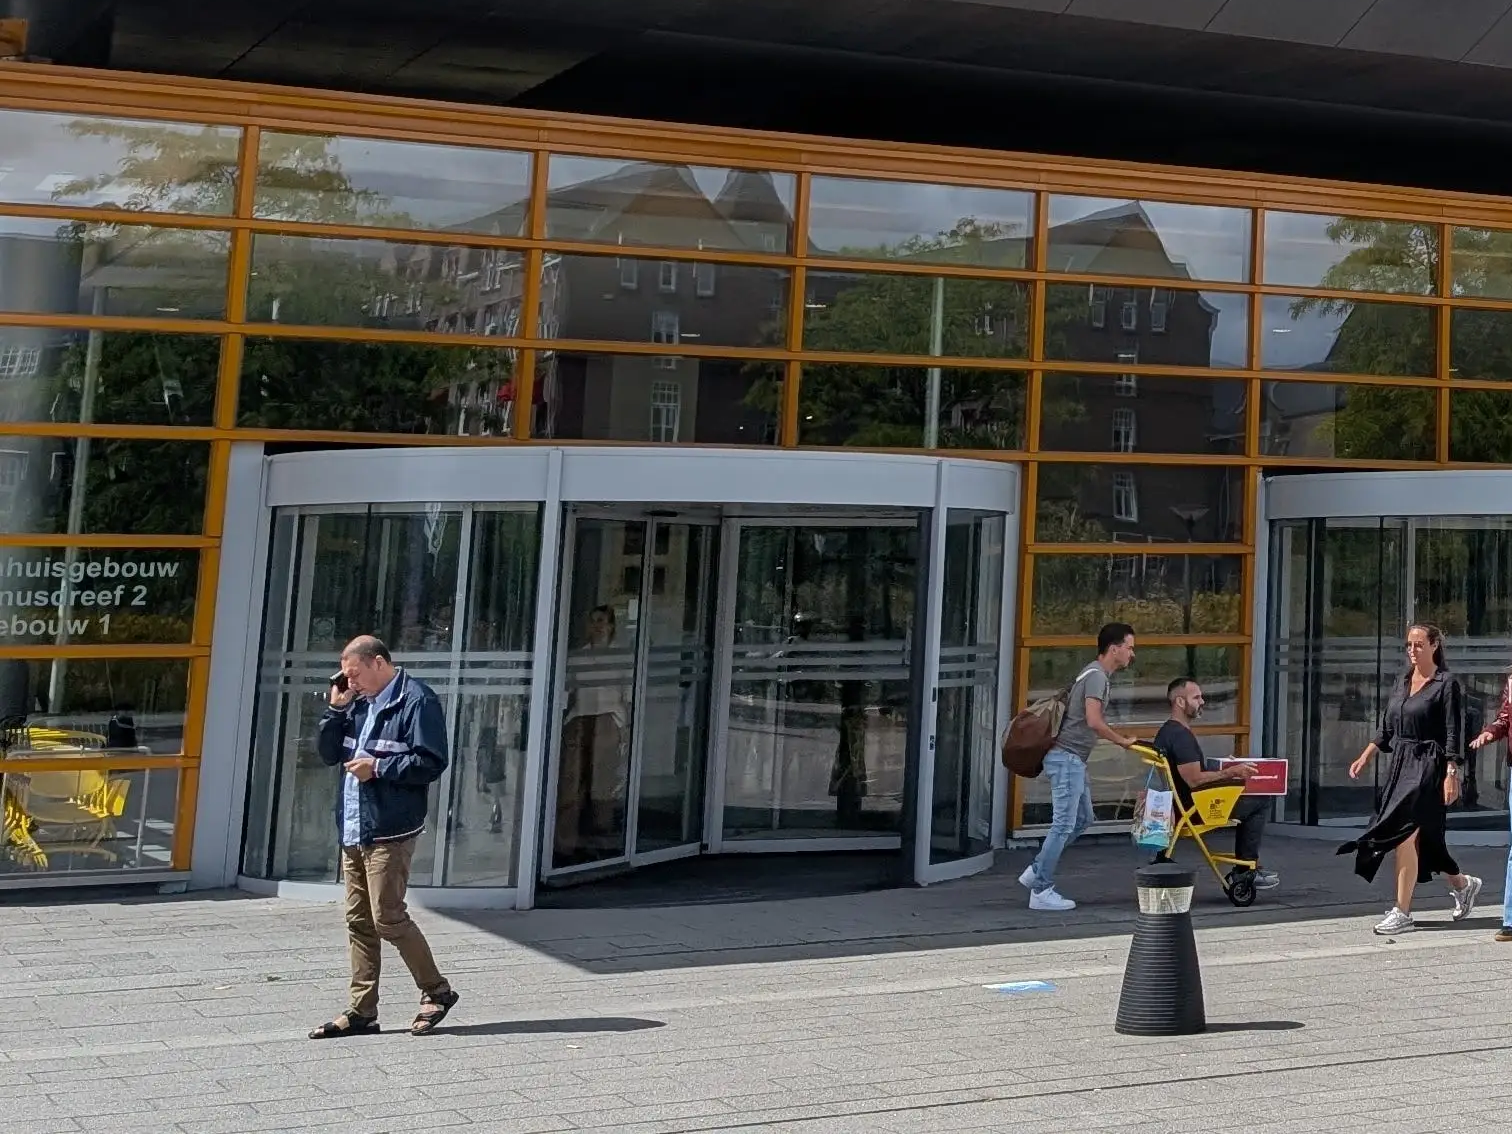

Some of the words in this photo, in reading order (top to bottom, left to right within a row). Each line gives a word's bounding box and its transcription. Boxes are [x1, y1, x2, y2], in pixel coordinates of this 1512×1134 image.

[0, 556, 180, 583] huisgebouw
[130, 584, 148, 606] 2
[98, 613, 111, 635] 1
